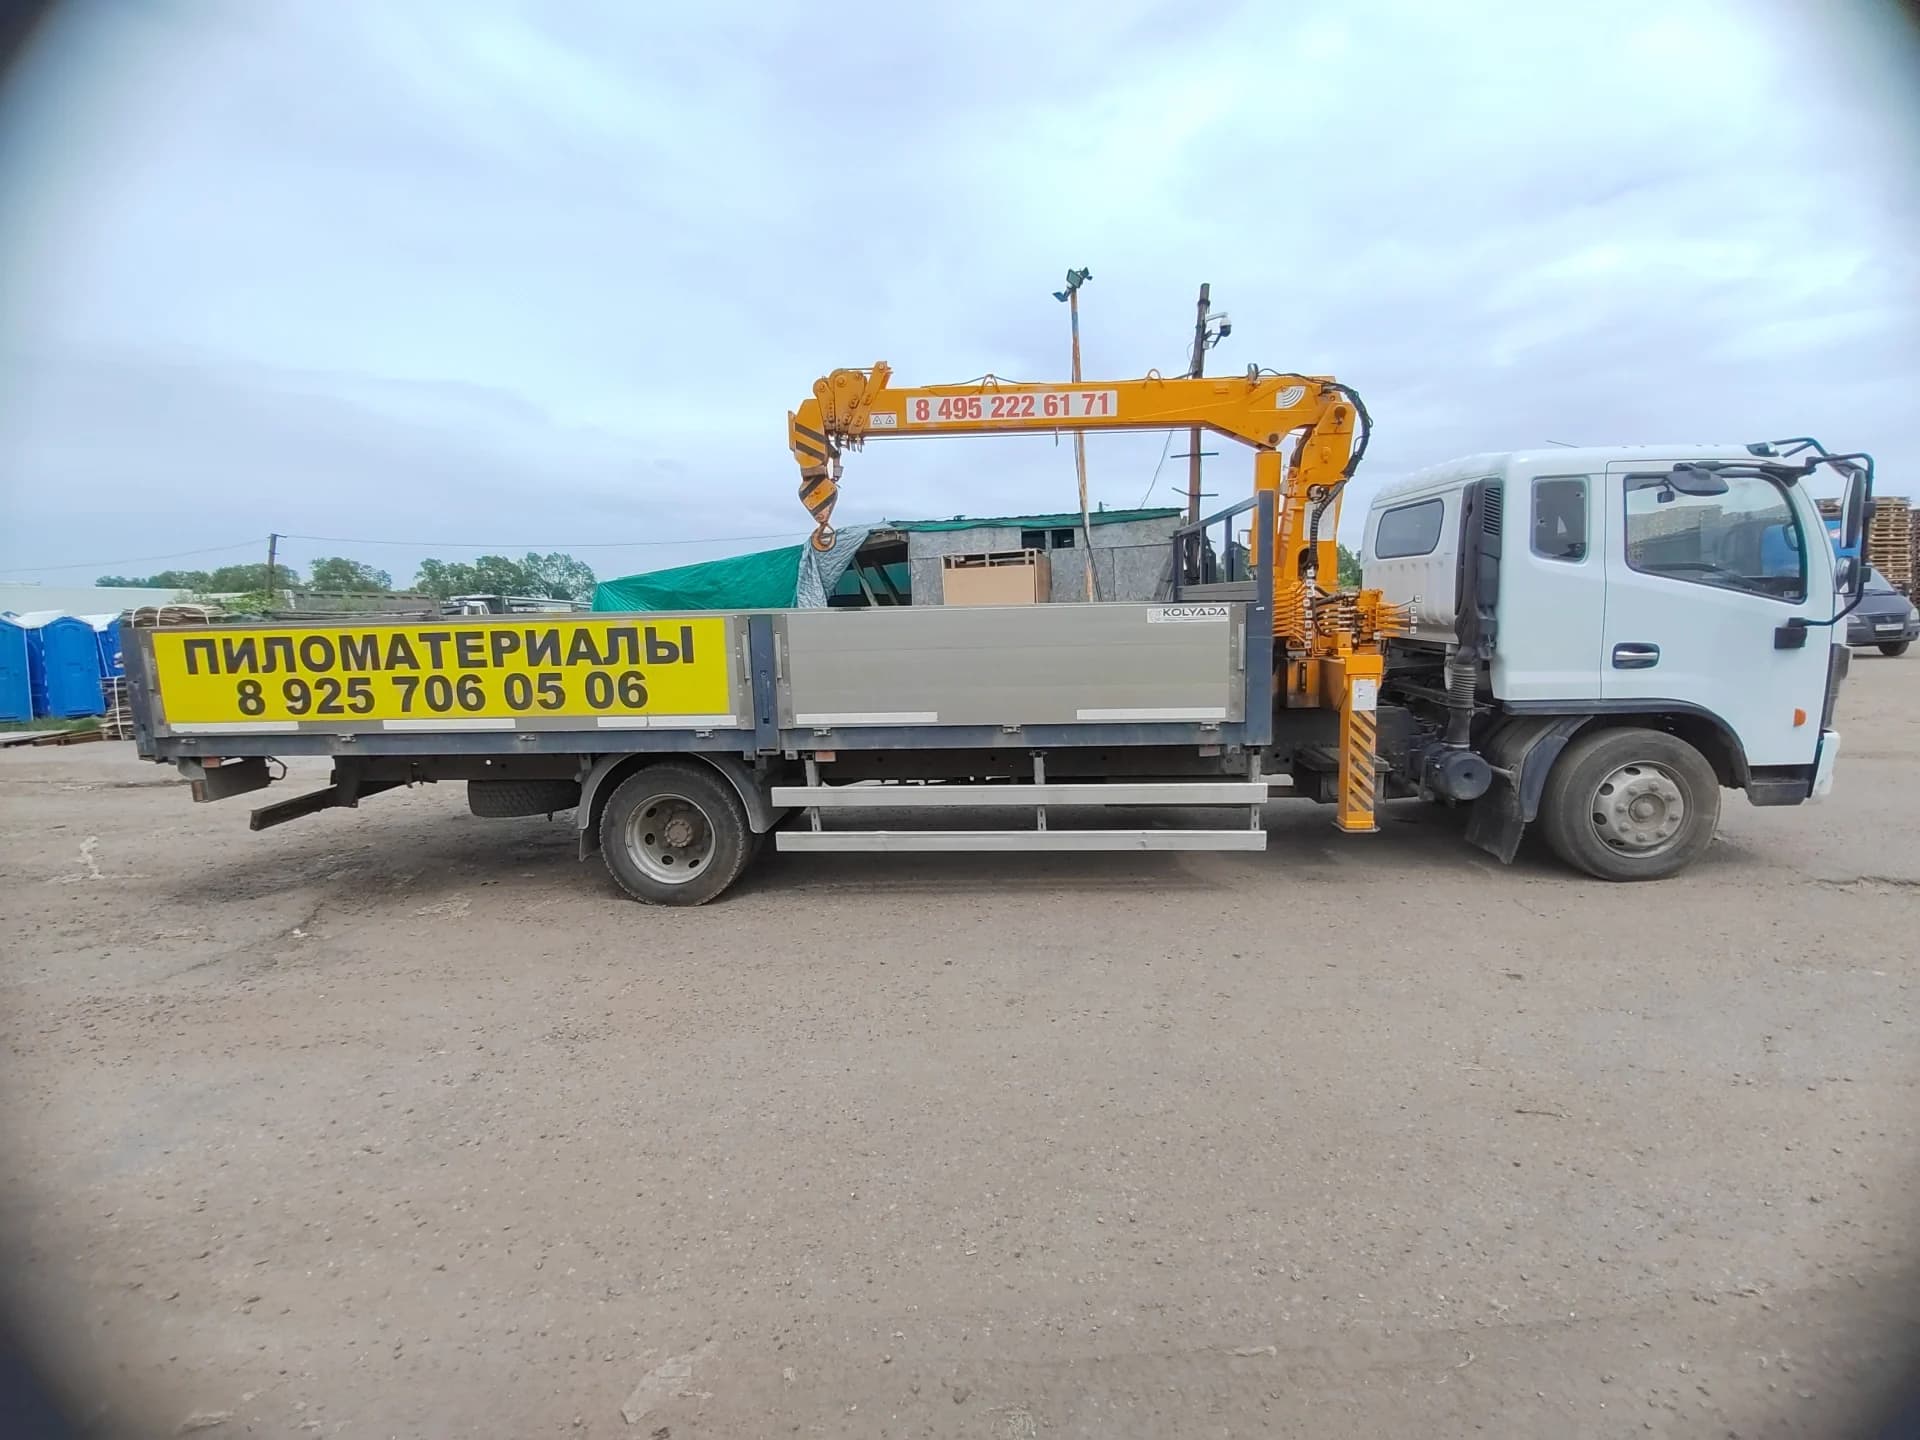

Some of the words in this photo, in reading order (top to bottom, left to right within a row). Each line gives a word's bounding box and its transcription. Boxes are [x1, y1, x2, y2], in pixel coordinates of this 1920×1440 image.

[915, 399, 930, 421] 8
[938, 397, 982, 419] 495
[991, 394, 1035, 418] 222
[1043, 393, 1070, 416] 61
[1082, 392, 1108, 415] 71
[1162, 607, 1227, 616] KOLYADA
[183, 626, 695, 675] ПИЛОМАТЕРИАЛЫ
[236, 679, 265, 716] 8
[282, 676, 375, 715] 925
[391, 674, 486, 712] 706
[504, 672, 566, 710] 05
[585, 671, 648, 709] 06
